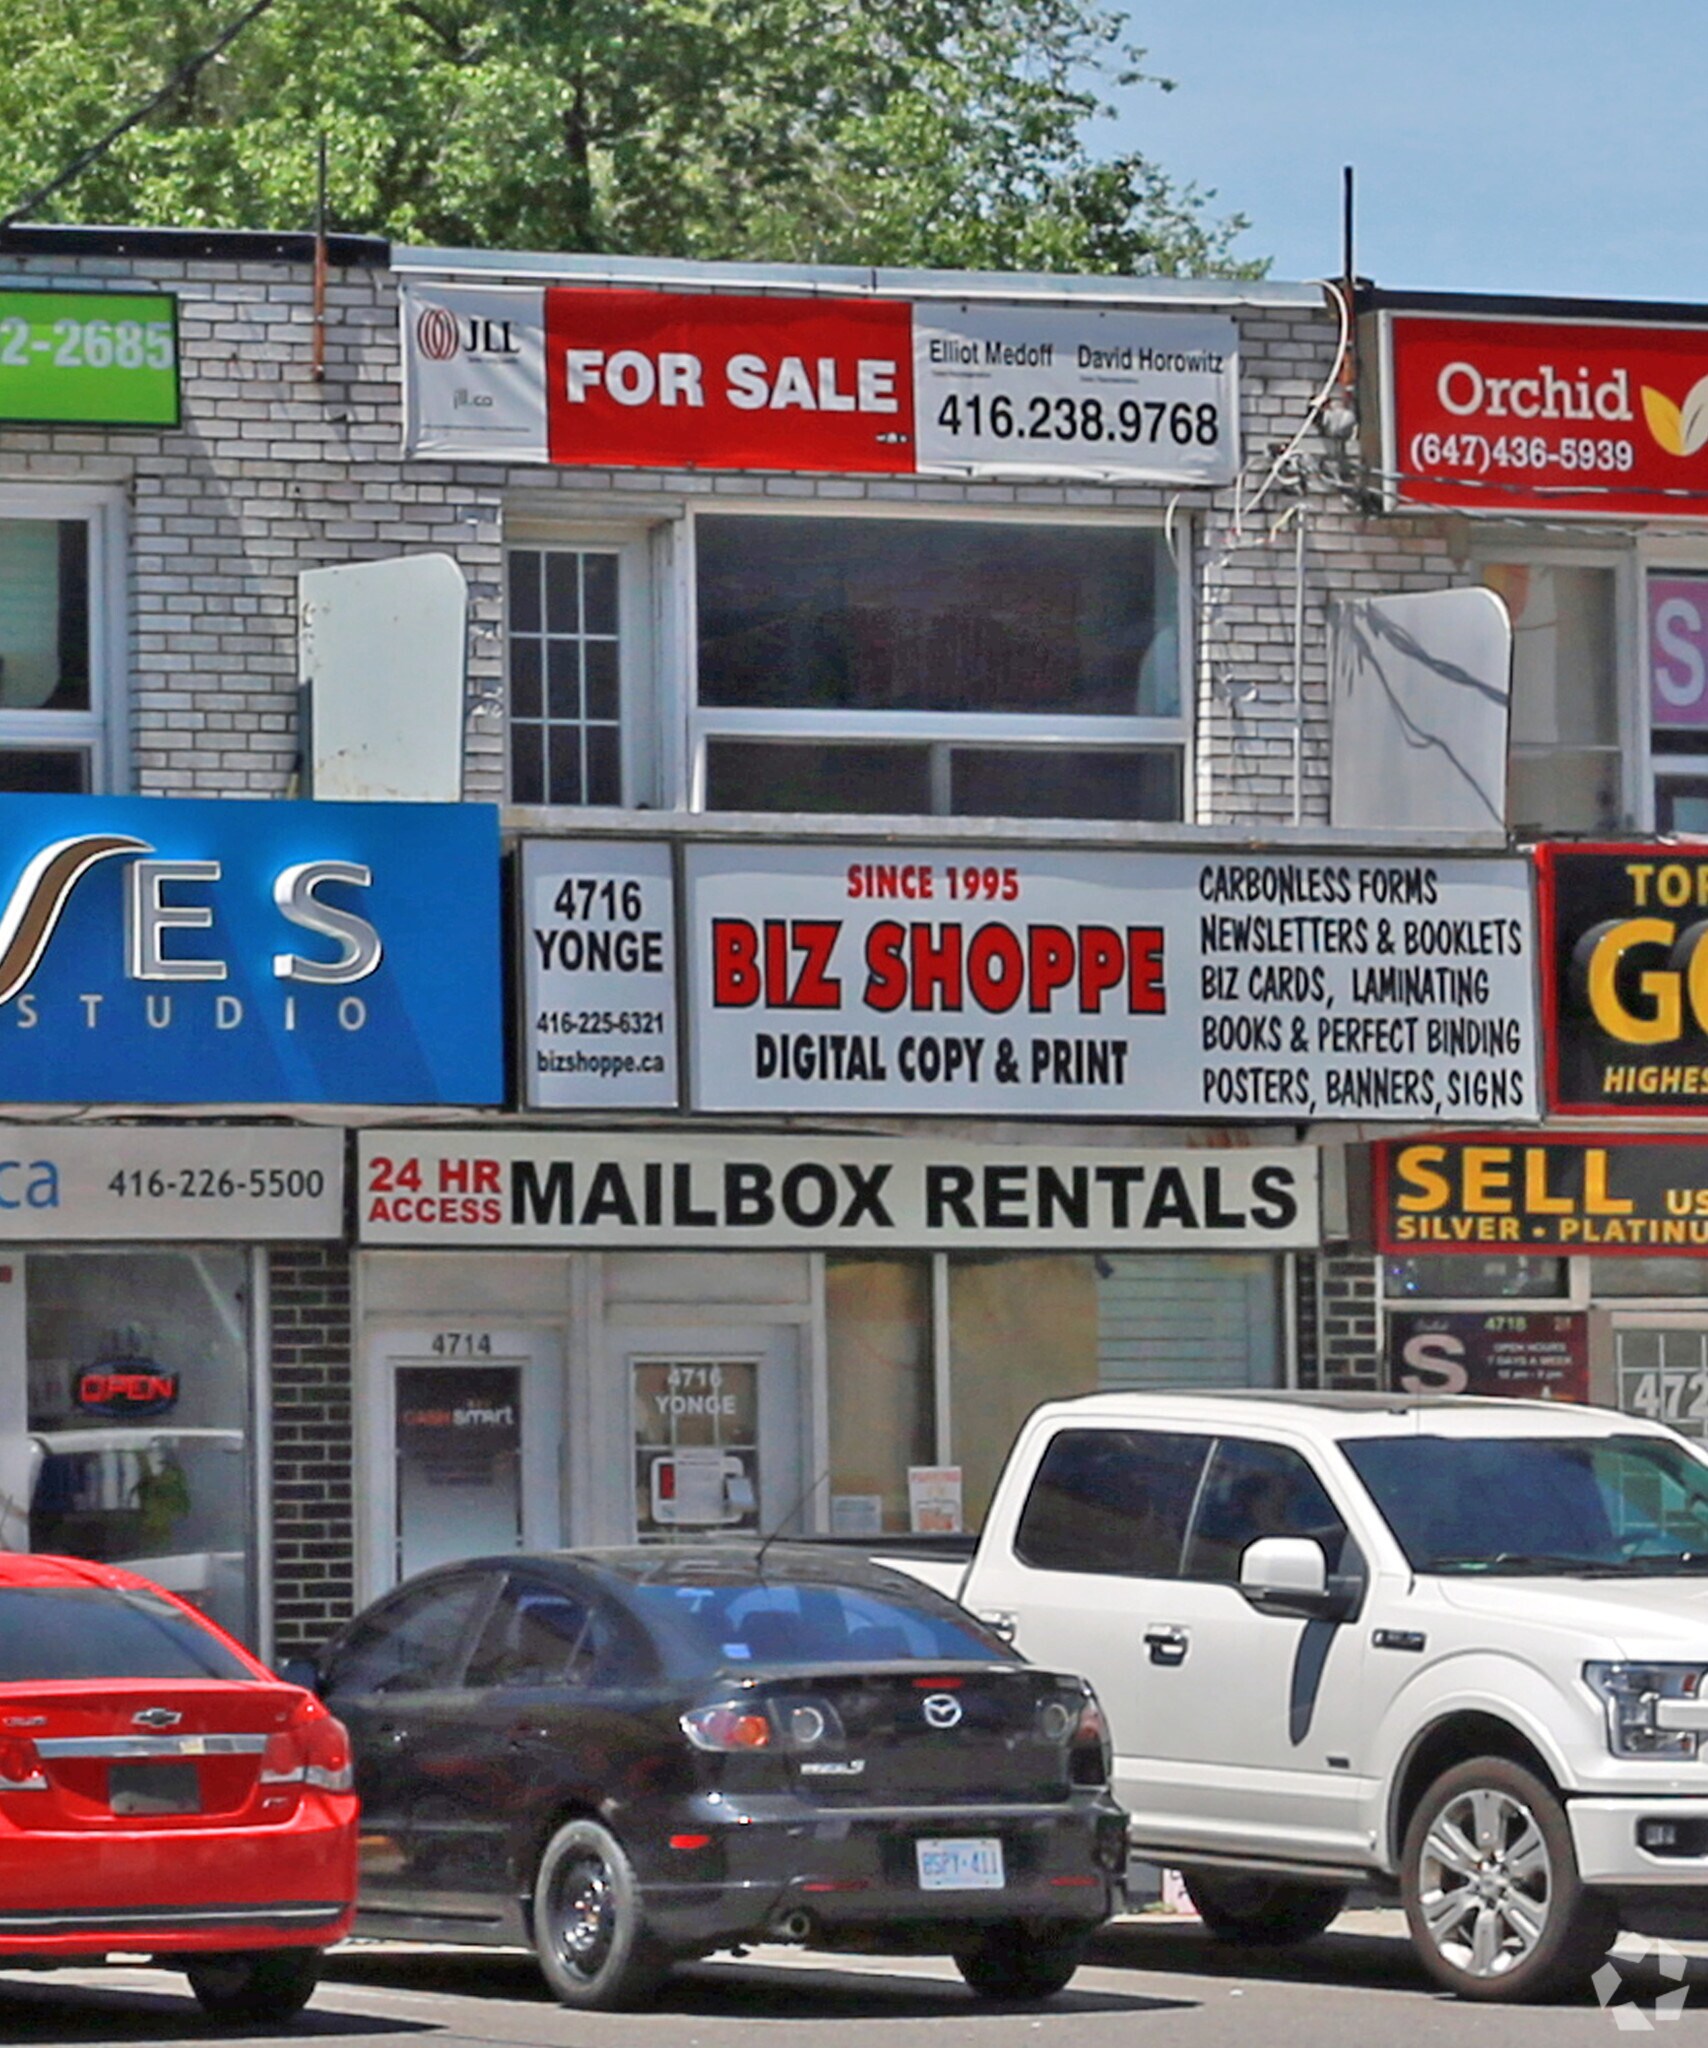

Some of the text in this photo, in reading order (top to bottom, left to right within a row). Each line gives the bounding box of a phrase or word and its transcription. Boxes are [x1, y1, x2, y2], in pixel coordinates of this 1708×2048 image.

[465, 319, 520, 354] JLL
[929, 339, 1224, 374] Elliot Medoff David Horowitz
[566, 349, 898, 413] FOR SALE
[1437, 361, 1634, 421] Orchid
[938, 394, 1219, 446] 416.238.9768
[1410, 433, 1634, 474] (647)436-5939
[554, 879, 641, 922] 4716
[847, 865, 1019, 901] SINCE 1995
[1199, 865, 1439, 905] CARBONLESS FORMS
[534, 929, 663, 972] YONGE
[1201, 913, 1522, 955] NEWSLETTERS & BOOKLETS
[711, 917, 1167, 1015] BIZ SHOPPE
[1587, 917, 1708, 1044] G
[1201, 965, 1490, 1009] BIZ CARDS, LAMINATING
[16, 994, 366, 1030] STUDIO
[536, 1011, 664, 1034] 416-225-6321
[1202, 1015, 1521, 1057] BOOKS & PERFECT BINDING
[537, 1051, 664, 1077] bizshoppe.ca
[755, 1033, 1128, 1086] DIGITAL COPY & PRINT
[1203, 1066, 1316, 1115] POSTERS,
[1447, 1070, 1524, 1108] SIGNS
[108, 1169, 324, 1198] 416-226-5500
[368, 1157, 502, 1194] 24 HR
[511, 1161, 1298, 1229] MAILBOX RENTALS
[1396, 1145, 1634, 1215] SELL
[368, 1198, 502, 1223] ACCESS
[1397, 1216, 1708, 1244] SILVER PLATINU
[432, 1333, 491, 1355] 4714
[82, 1374, 173, 1403] OPEN
[655, 1396, 736, 1415] YONGE
